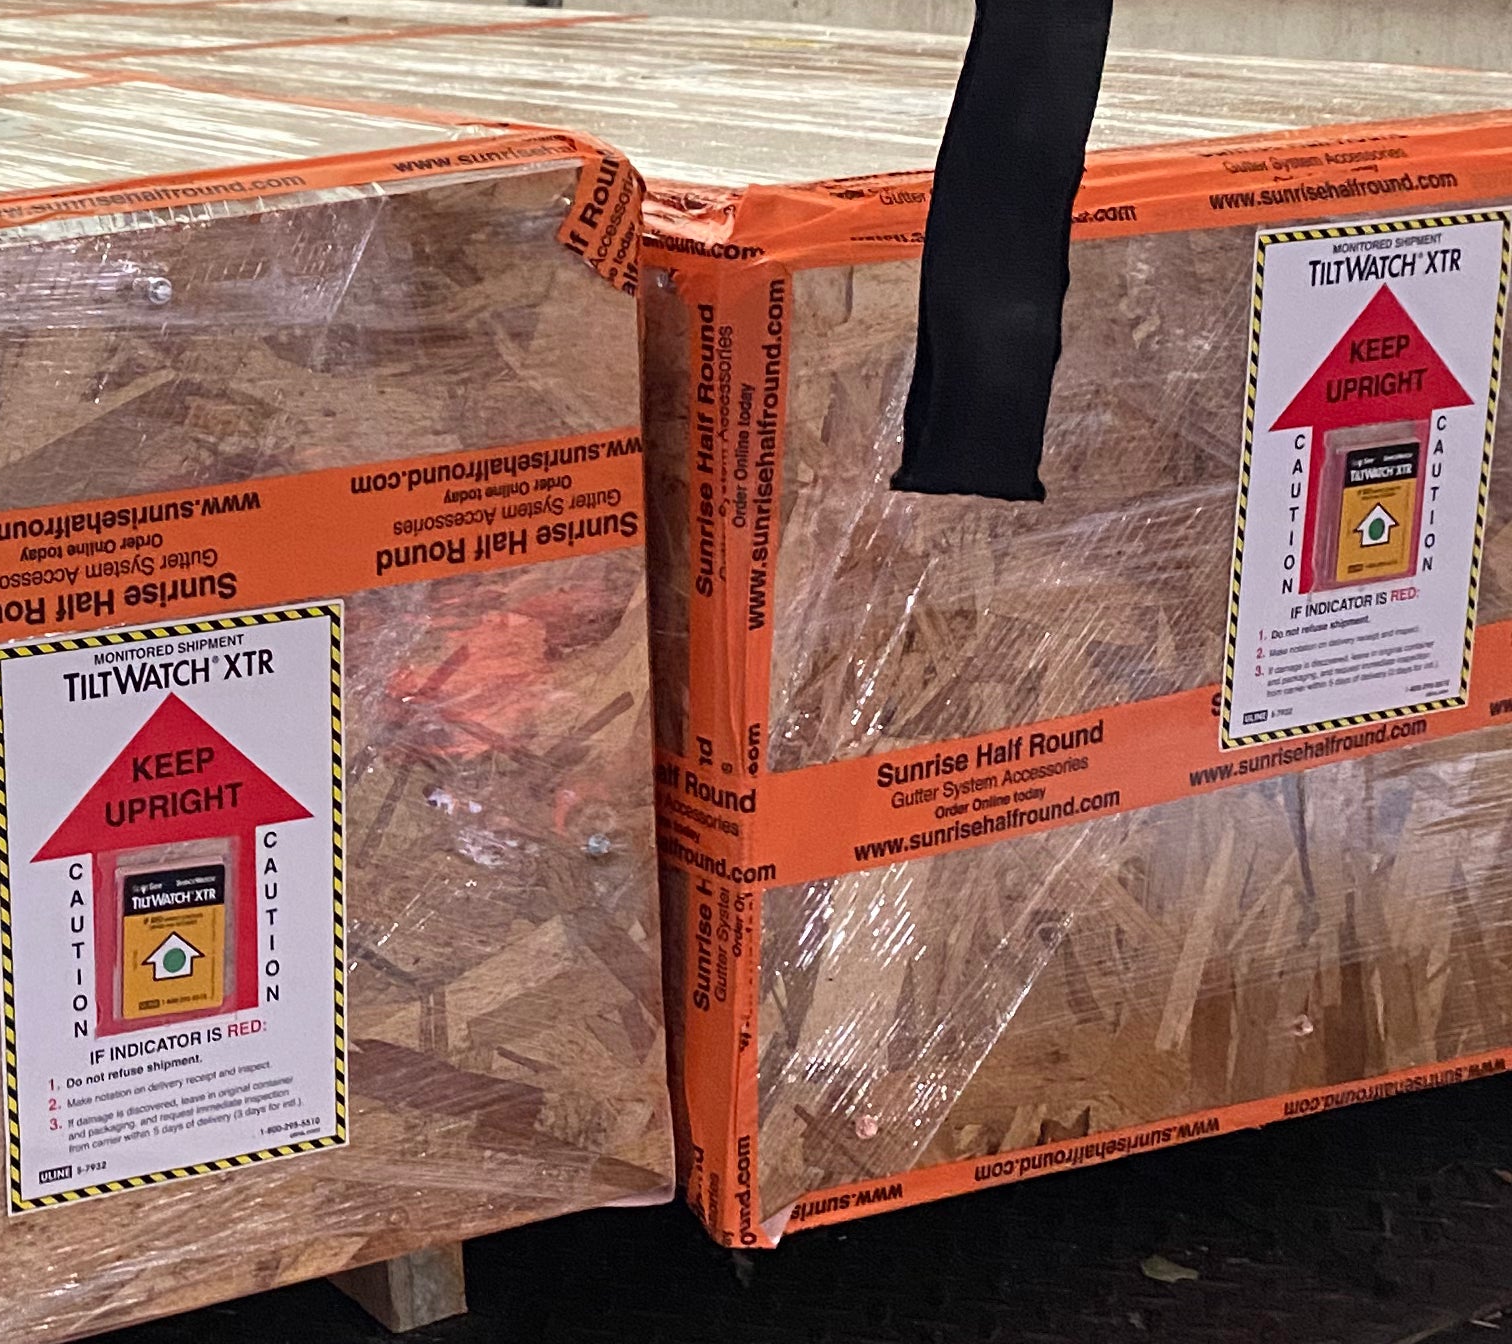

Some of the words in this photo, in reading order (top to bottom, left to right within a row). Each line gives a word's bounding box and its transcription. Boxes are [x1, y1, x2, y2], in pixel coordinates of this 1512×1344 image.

[1209, 170, 1458, 210] www.sunrisehalfround.com
[1425, 248, 1462, 274] XTR
[695, 303, 715, 405] Round
[1349, 334, 1411, 364] KEEP
[1326, 368, 1429, 403] UPRIGHT
[736, 383, 756, 426] today
[695, 412, 715, 474] Half
[733, 430, 751, 481] Online
[747, 278, 785, 631] www.sunrisehalfround.com
[443, 487, 482, 504] today
[534, 475, 572, 491] Order
[570, 489, 621, 509] Gutter
[393, 509, 496, 535] Accessories
[502, 497, 564, 520] System
[731, 484, 748, 529] Order
[120, 533, 163, 552] Order
[474, 529, 527, 561] Half
[536, 511, 639, 547] Sunrise
[695, 482, 716, 596] Sunrise
[20, 544, 63, 563] today
[66, 540, 116, 559] Online
[159, 548, 218, 570] Gutter
[376, 537, 465, 576] Round
[85, 555, 154, 581] System
[55, 588, 115, 622] Half
[124, 572, 237, 609] Sunrise
[1290, 605, 1303, 619] IF
[1306, 595, 1372, 617] INDICATOR
[1376, 592, 1387, 605] IS
[1390, 587, 1420, 602] RED:
[94, 643, 174, 665] MONITORED
[178, 634, 244, 654] SHIPMENT
[224, 648, 274, 680] XTR
[132, 746, 215, 783] KEEP
[877, 753, 968, 788] Sunrise
[976, 740, 1022, 768] Half
[1029, 720, 1104, 758] Round
[1189, 718, 1428, 787] www.sunrisehalfround.com
[685, 772, 756, 814] Round
[891, 786, 939, 809] Gutter
[942, 776, 998, 800] System
[1001, 754, 1089, 786] Accessories
[105, 782, 244, 827] UPRIGHT
[935, 803, 968, 819] Order
[1013, 786, 1047, 805] today
[854, 789, 1120, 862] www.sunrisehalfround.com
[194, 888, 216, 902] XTR
[693, 903, 712, 1012] Sunrise
[714, 945, 730, 1003] Gutter
[90, 1049, 105, 1065] IF
[110, 1032, 201, 1061] INDICATOR
[207, 1027, 222, 1043] IS
[228, 1019, 267, 1038] RED:
[48, 1099, 61, 1111] 2.
[67, 1096, 92, 1108] Make
[95, 1088, 132, 1103] notation
[148, 1077, 184, 1093] delivery
[219, 1066, 236, 1078] and
[66, 1077, 82, 1089] Do
[86, 1071, 105, 1085] not
[108, 1064, 144, 1079] refuse
[147, 1054, 203, 1073] shipment.
[49, 1117, 62, 1131] 3.
[76, 1113, 114, 1128] damage
[68, 1130, 86, 1141] and
[974, 1117, 1220, 1182] www.sunrisehalfround.com
[40, 1166, 72, 1182] ULINE
